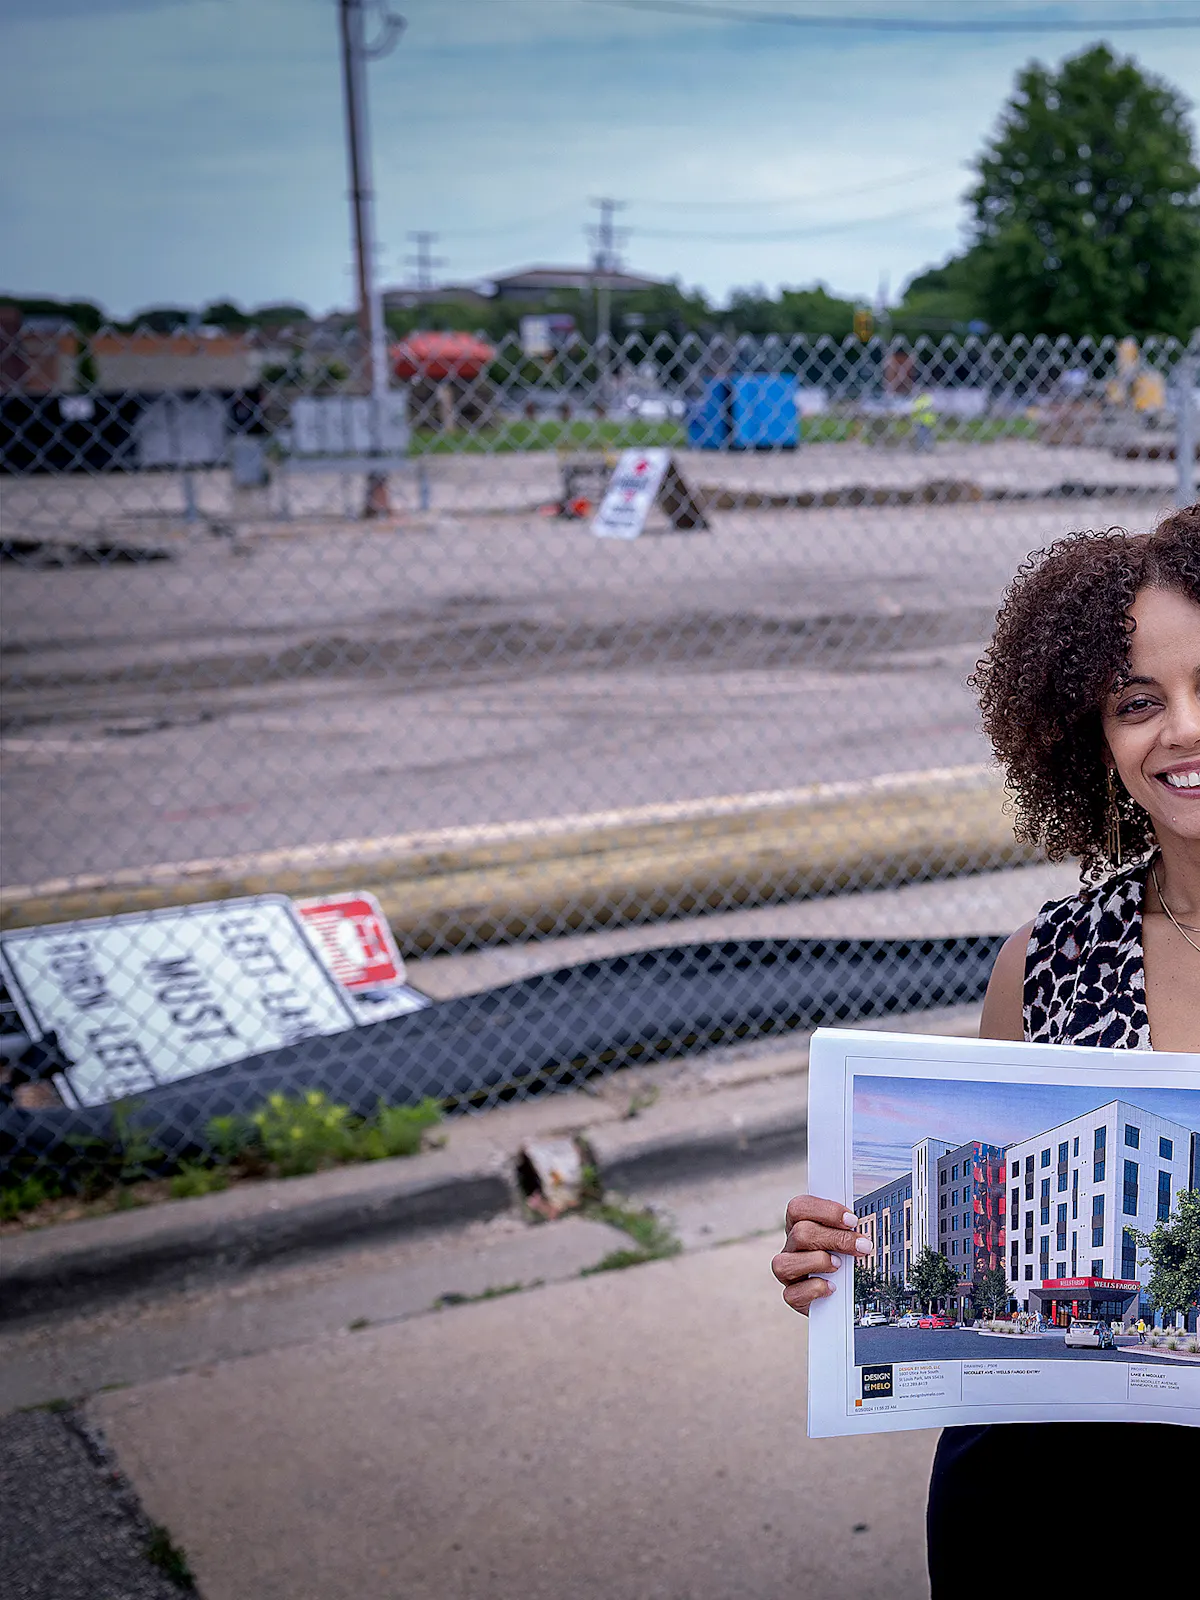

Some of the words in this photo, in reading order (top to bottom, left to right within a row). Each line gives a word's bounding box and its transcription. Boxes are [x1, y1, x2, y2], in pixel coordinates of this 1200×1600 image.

[219, 917, 287, 976] LEFT
[142, 952, 237, 1043] MUST
[1094, 1280, 1116, 1289] WELLS
[1116, 1282, 1137, 1291] FARGO
[864, 1372, 890, 1381] DESIGN
[871, 1382, 891, 1390] MELO
